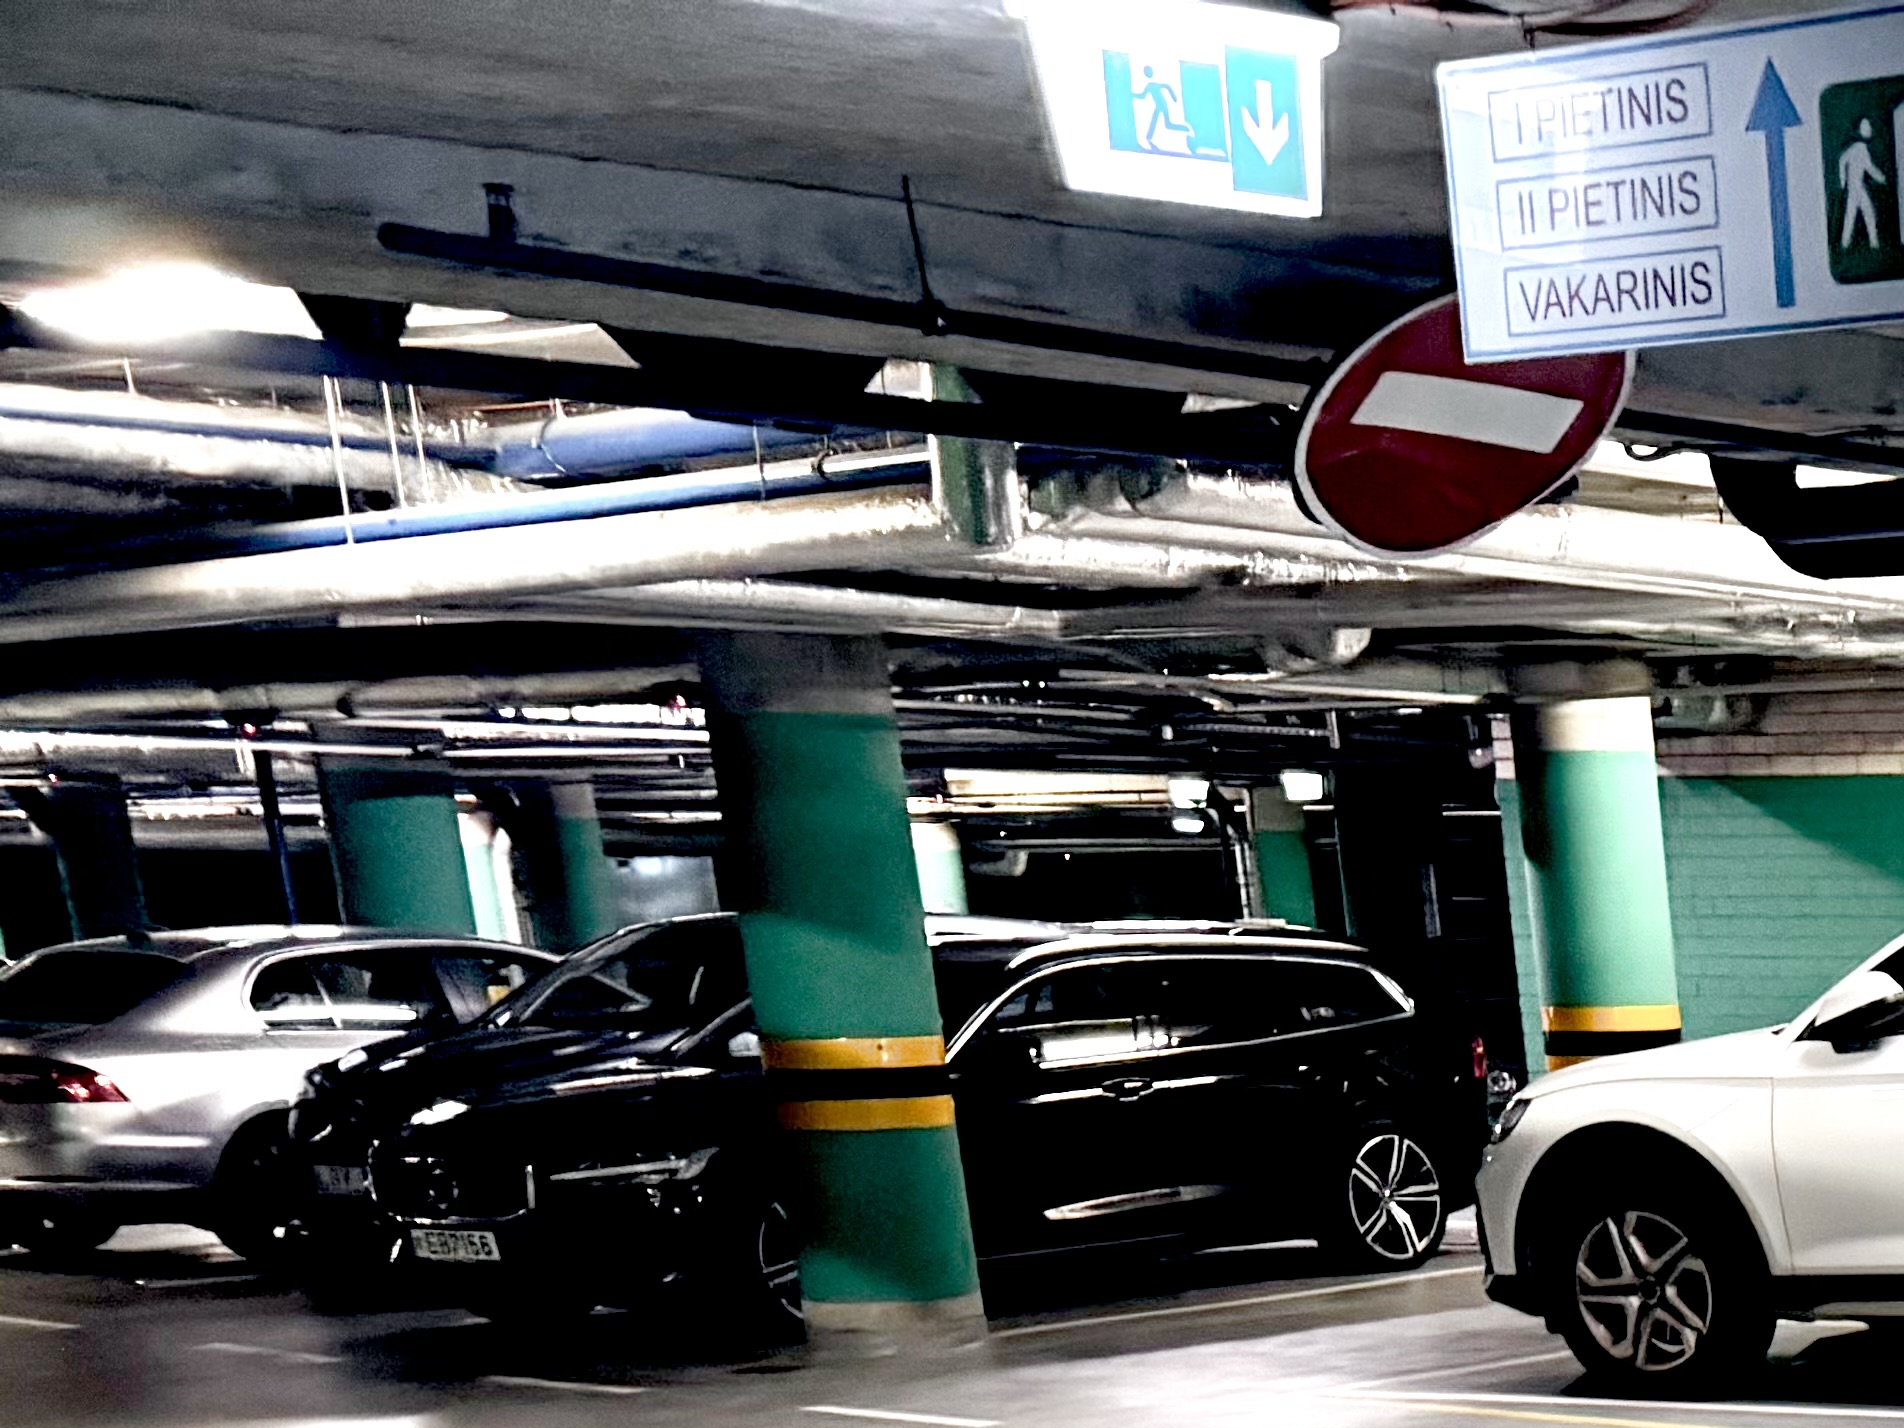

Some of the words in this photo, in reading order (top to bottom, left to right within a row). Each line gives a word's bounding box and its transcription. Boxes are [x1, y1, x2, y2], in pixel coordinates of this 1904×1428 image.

[1536, 78, 1689, 143] PIETINIS
[1518, 189, 1536, 235] II
[1548, 170, 1701, 232] PIETINIS
[1518, 261, 1713, 322] VAKARINIS
